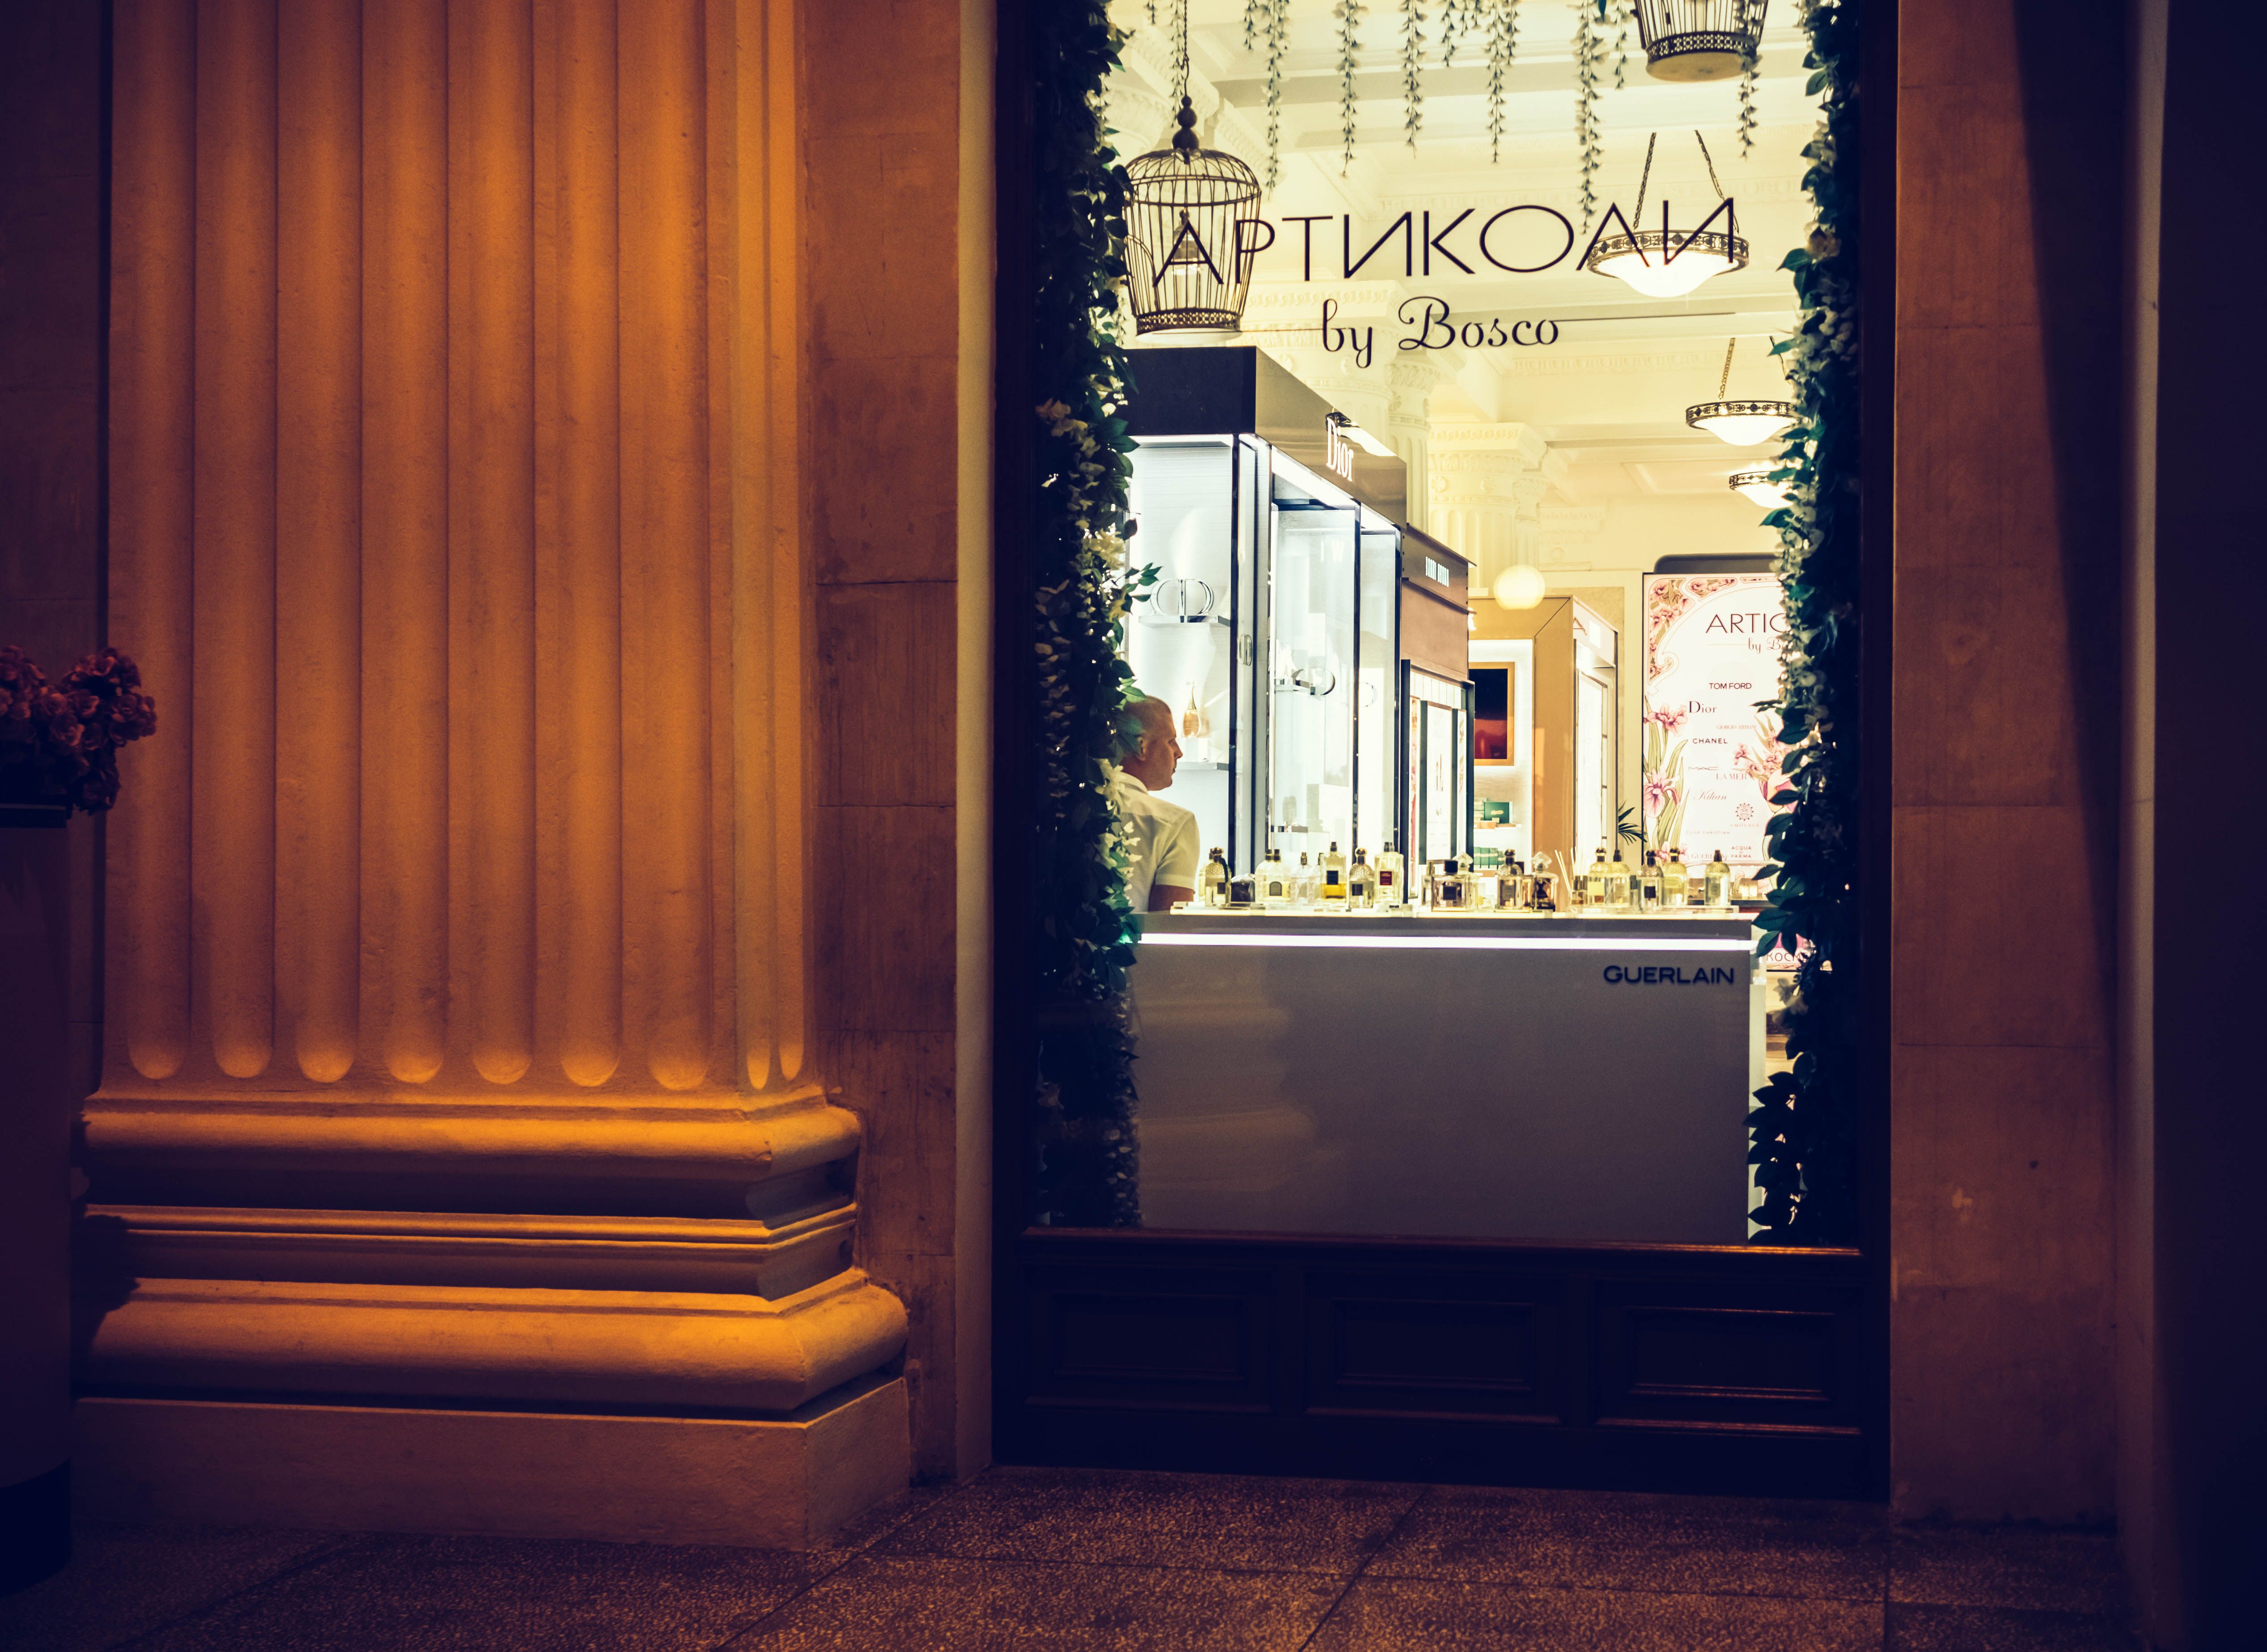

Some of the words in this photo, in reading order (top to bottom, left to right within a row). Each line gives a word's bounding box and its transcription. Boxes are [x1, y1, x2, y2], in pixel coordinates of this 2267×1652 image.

[1153, 197, 1734, 287] АРТИКОЛИ
[1323, 299, 1373, 368] by
[1398, 296, 1558, 350] Bosco
[1326, 417, 1354, 482] Dior
[1748, 637, 1761, 654] by
[1689, 701, 1717, 713] Dior
[1603, 965, 1734, 984] GUERLAIN
